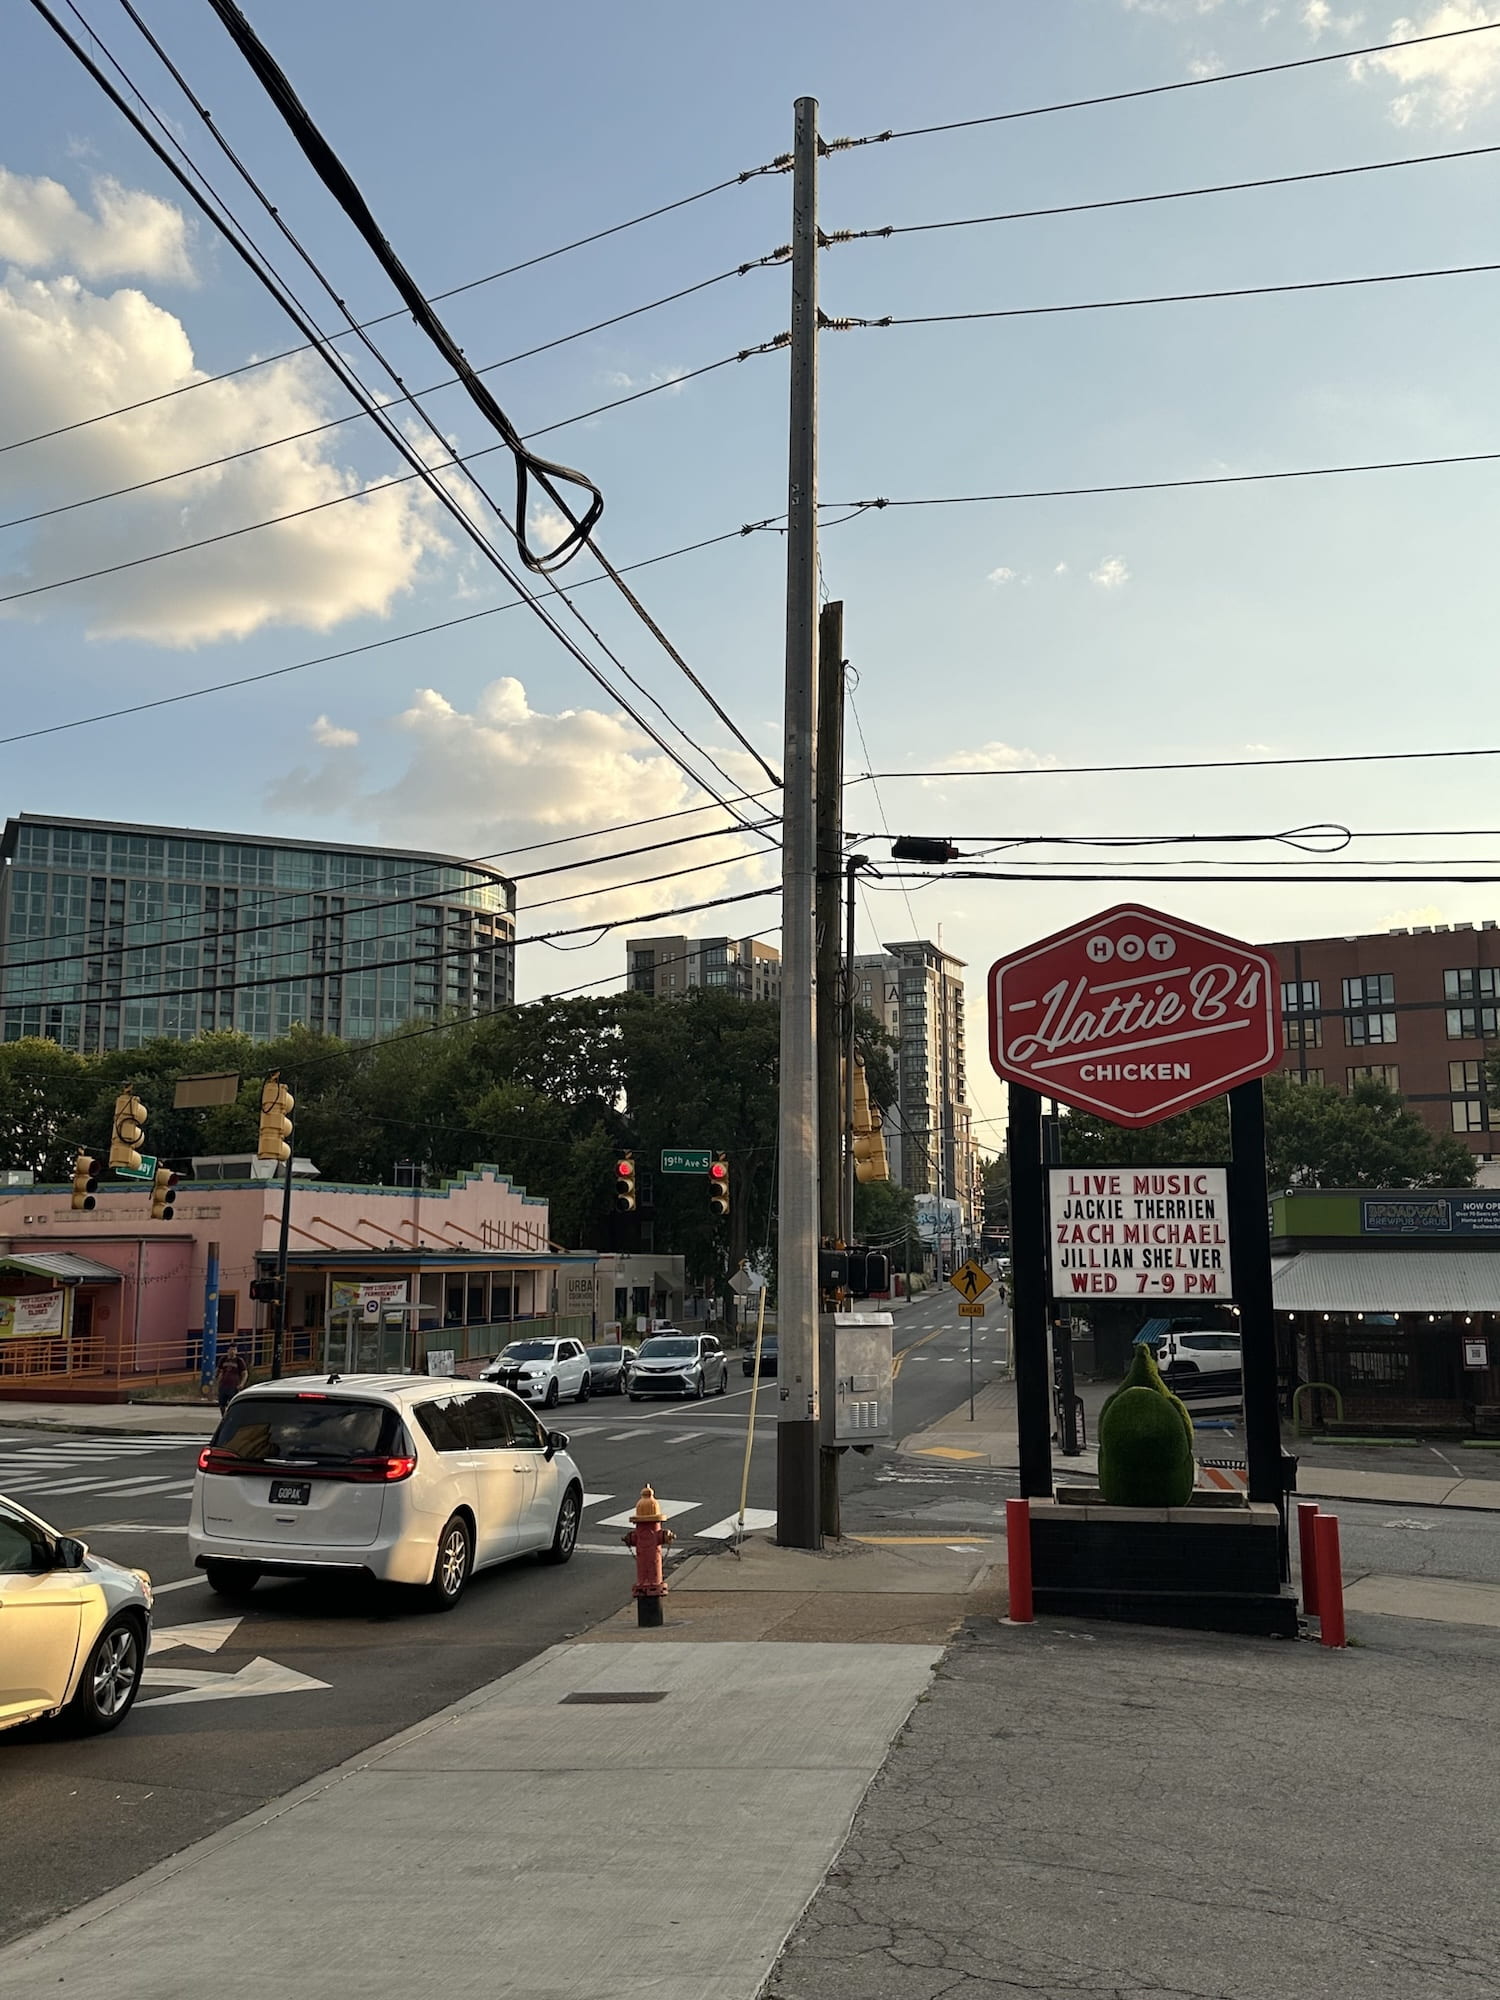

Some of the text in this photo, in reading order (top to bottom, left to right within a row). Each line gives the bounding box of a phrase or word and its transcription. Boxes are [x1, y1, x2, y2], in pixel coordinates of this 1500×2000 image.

[1092, 938, 1170, 958] HOT
[1007, 963, 1261, 1062] Hattie B's
[1079, 1063, 1191, 1082] CHICKEN
[664, 1156, 709, 1168] 19th Ave S
[1068, 1175, 1208, 1195] LIVE MUSIC
[1063, 1199, 1215, 1220] JACKIE THERRIEN
[1463, 1202, 1484, 1211] NOW
[1369, 1217, 1414, 1226] BREWPUB
[1422, 1217, 1449, 1226] GRUB
[1057, 1223, 1226, 1244] ZACH MICHAEL
[1061, 1247, 1221, 1268] JILLIAN SHELVER
[1071, 1273, 1217, 1294] WED 7-9 PM
